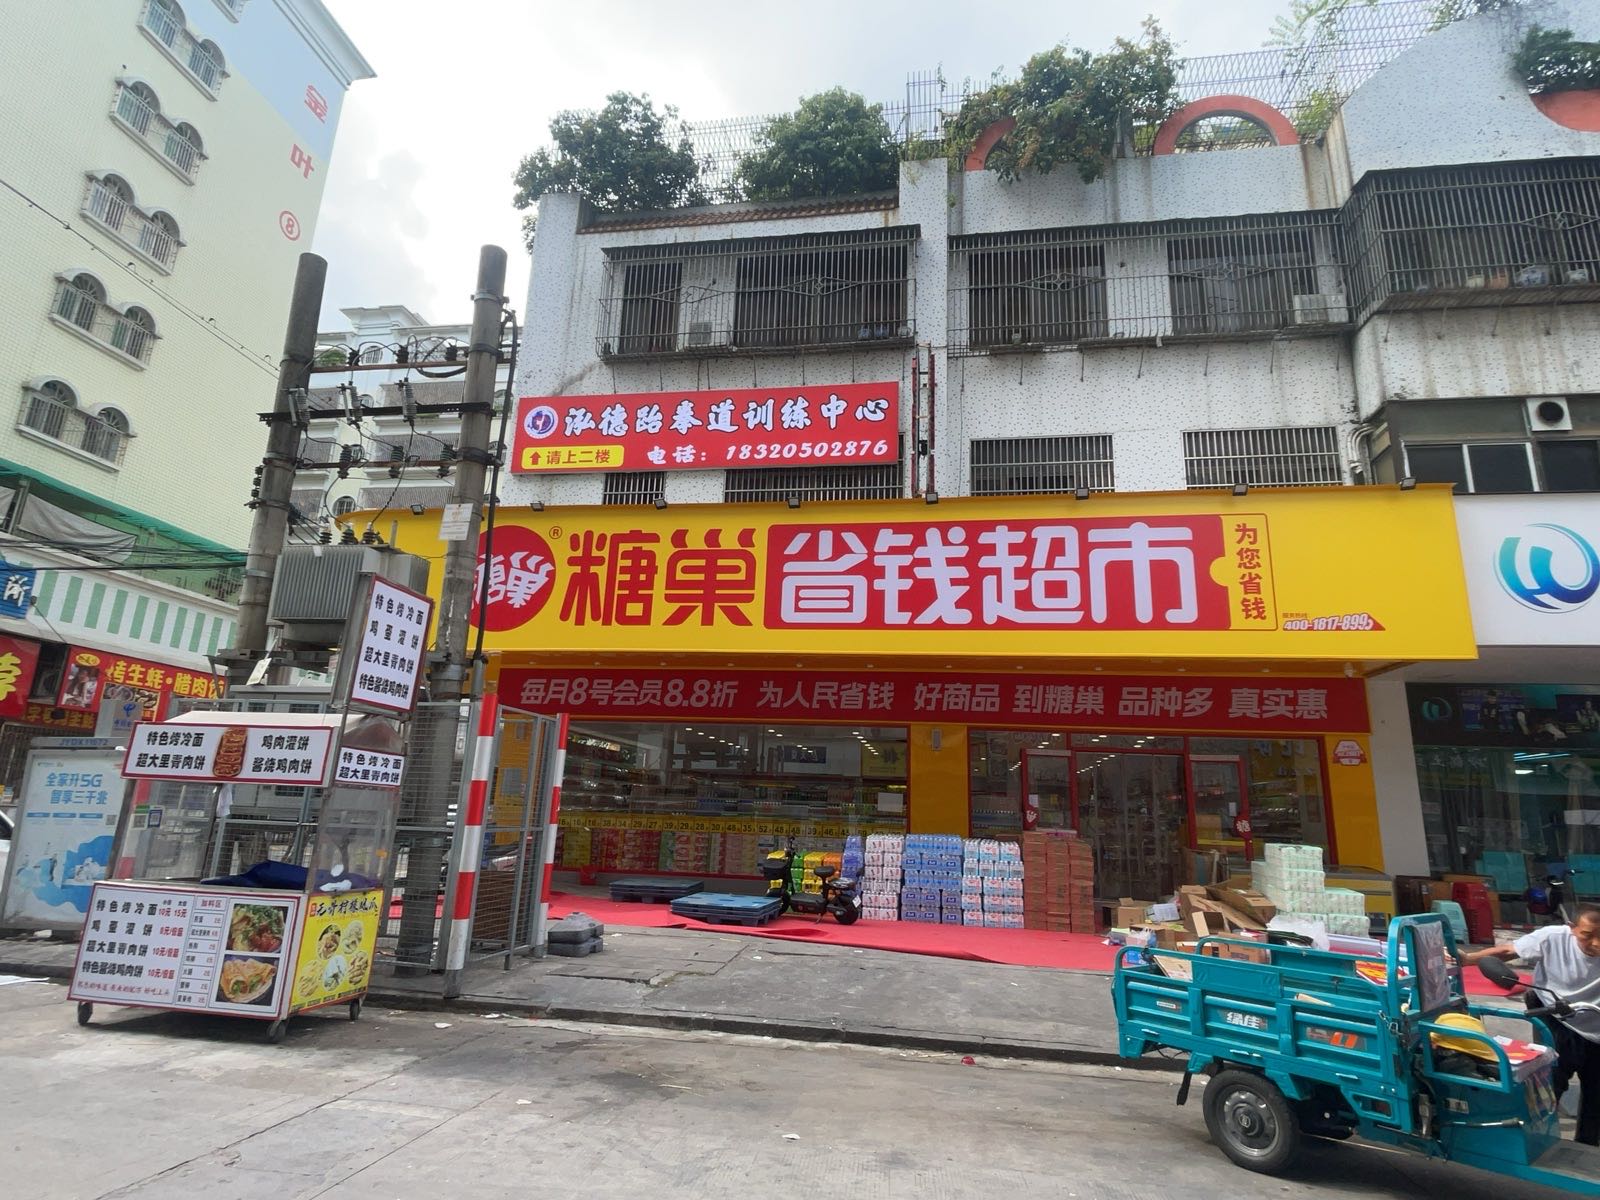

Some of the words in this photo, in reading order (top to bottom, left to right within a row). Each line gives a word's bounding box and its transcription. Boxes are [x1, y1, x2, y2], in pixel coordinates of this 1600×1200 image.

[563, 394, 890, 438] 泓德跆拳道训练中心
[546, 449, 610, 465] 请上二楼
[726, 439, 888, 461] 18320502876
[559, 529, 757, 626] 糖巢
[781, 522, 1199, 625] 省钱超市
[1235, 523, 1266, 620] 为您省钱
[375, 593, 424, 625] 特色烤冷面
[369, 620, 419, 650] 鸡蛋灌饼
[520, 677, 738, 708] 每月8号会员8.8折
[756, 681, 894, 709] 为人民省钱
[913, 683, 1000, 712] 好商品
[1012, 684, 1104, 716] 到糖巢
[1118, 687, 1213, 718] 品种多
[1228, 688, 1328, 720] 真实惠
[146, 731, 204, 748] 特色烤冷面
[261, 734, 309, 752] 鸡肉灌饼
[252, 757, 312, 775] 酱烧鸡肉饼
[342, 751, 402, 770] 特色烤冷面
[96, 899, 158, 916] 特色烤冷面
